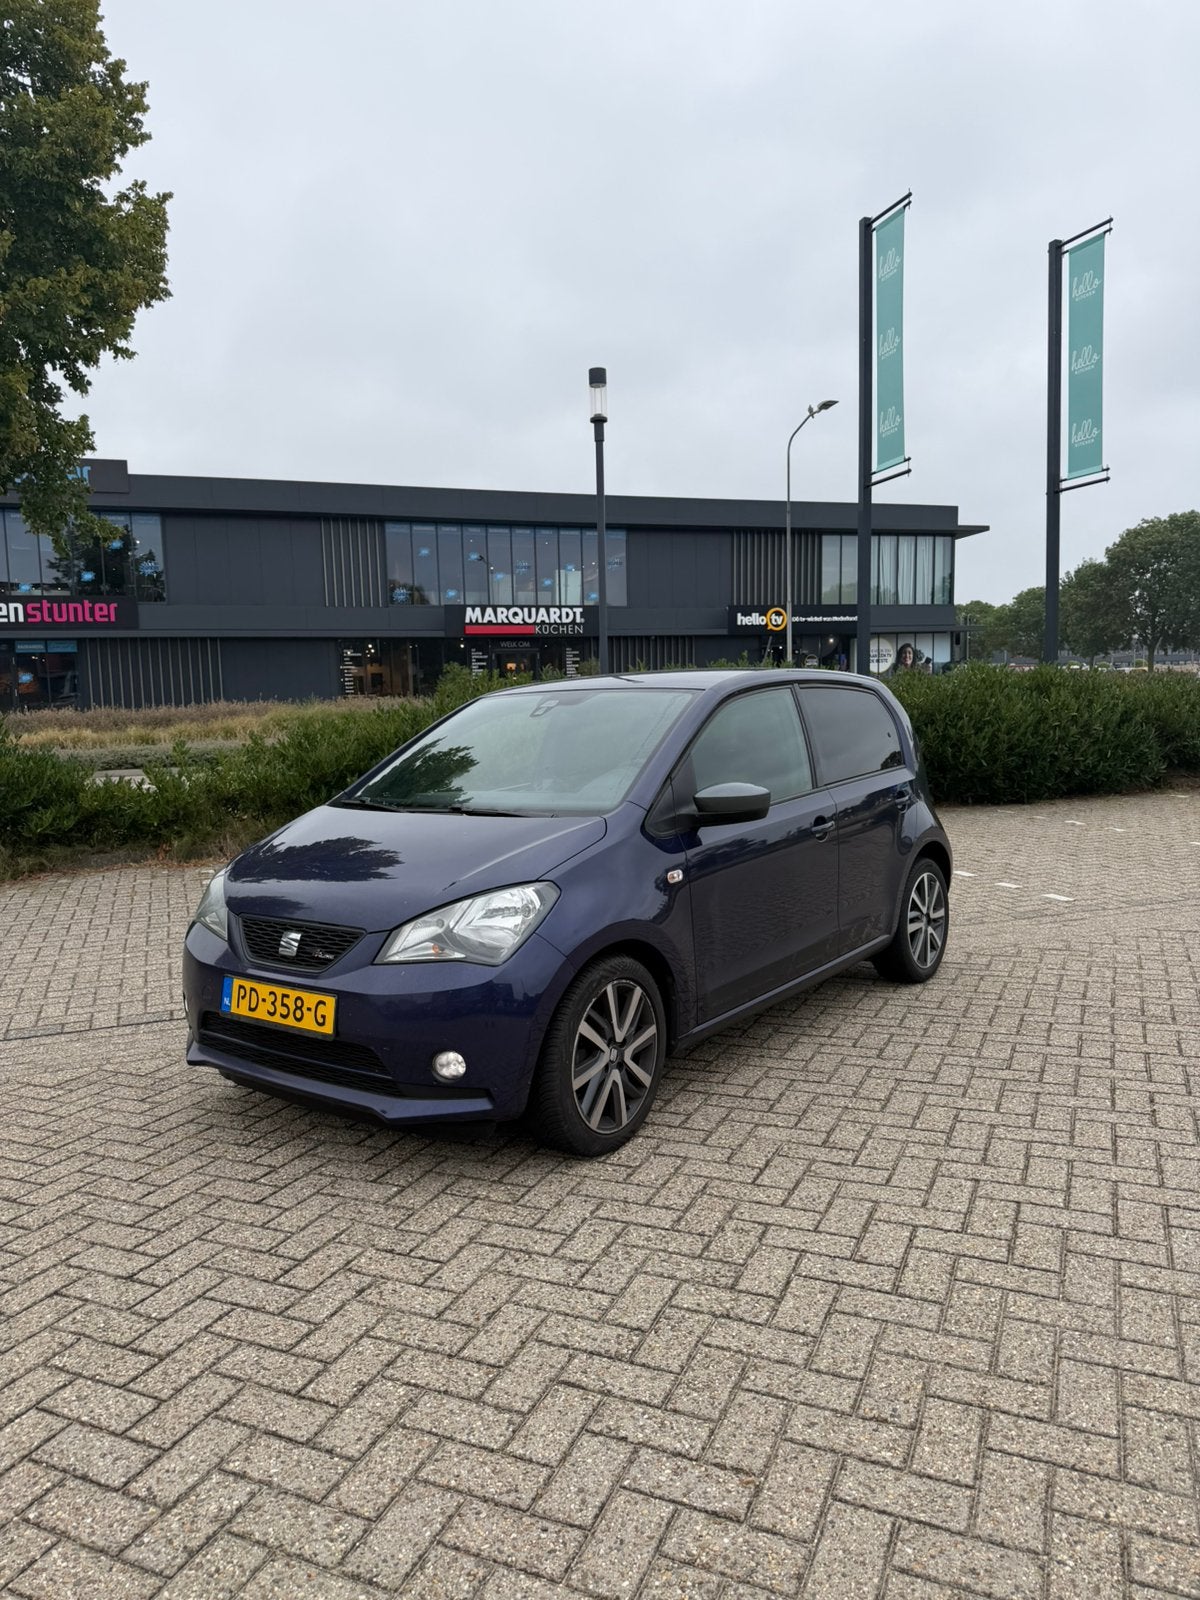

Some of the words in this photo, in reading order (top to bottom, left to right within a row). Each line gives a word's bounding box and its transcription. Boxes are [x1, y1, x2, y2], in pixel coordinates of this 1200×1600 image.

[879, 247, 901, 278] hello
[1072, 270, 1101, 298] hello
[879, 327, 901, 356] hello
[1071, 344, 1100, 371] hello
[880, 405, 902, 433] hello
[1071, 418, 1100, 444] hello
[465, 606, 584, 624] MARQUARDT
[737, 612, 767, 625] hello
[771, 613, 783, 625] tv
[236, 984, 327, 1027] PD-358-G
